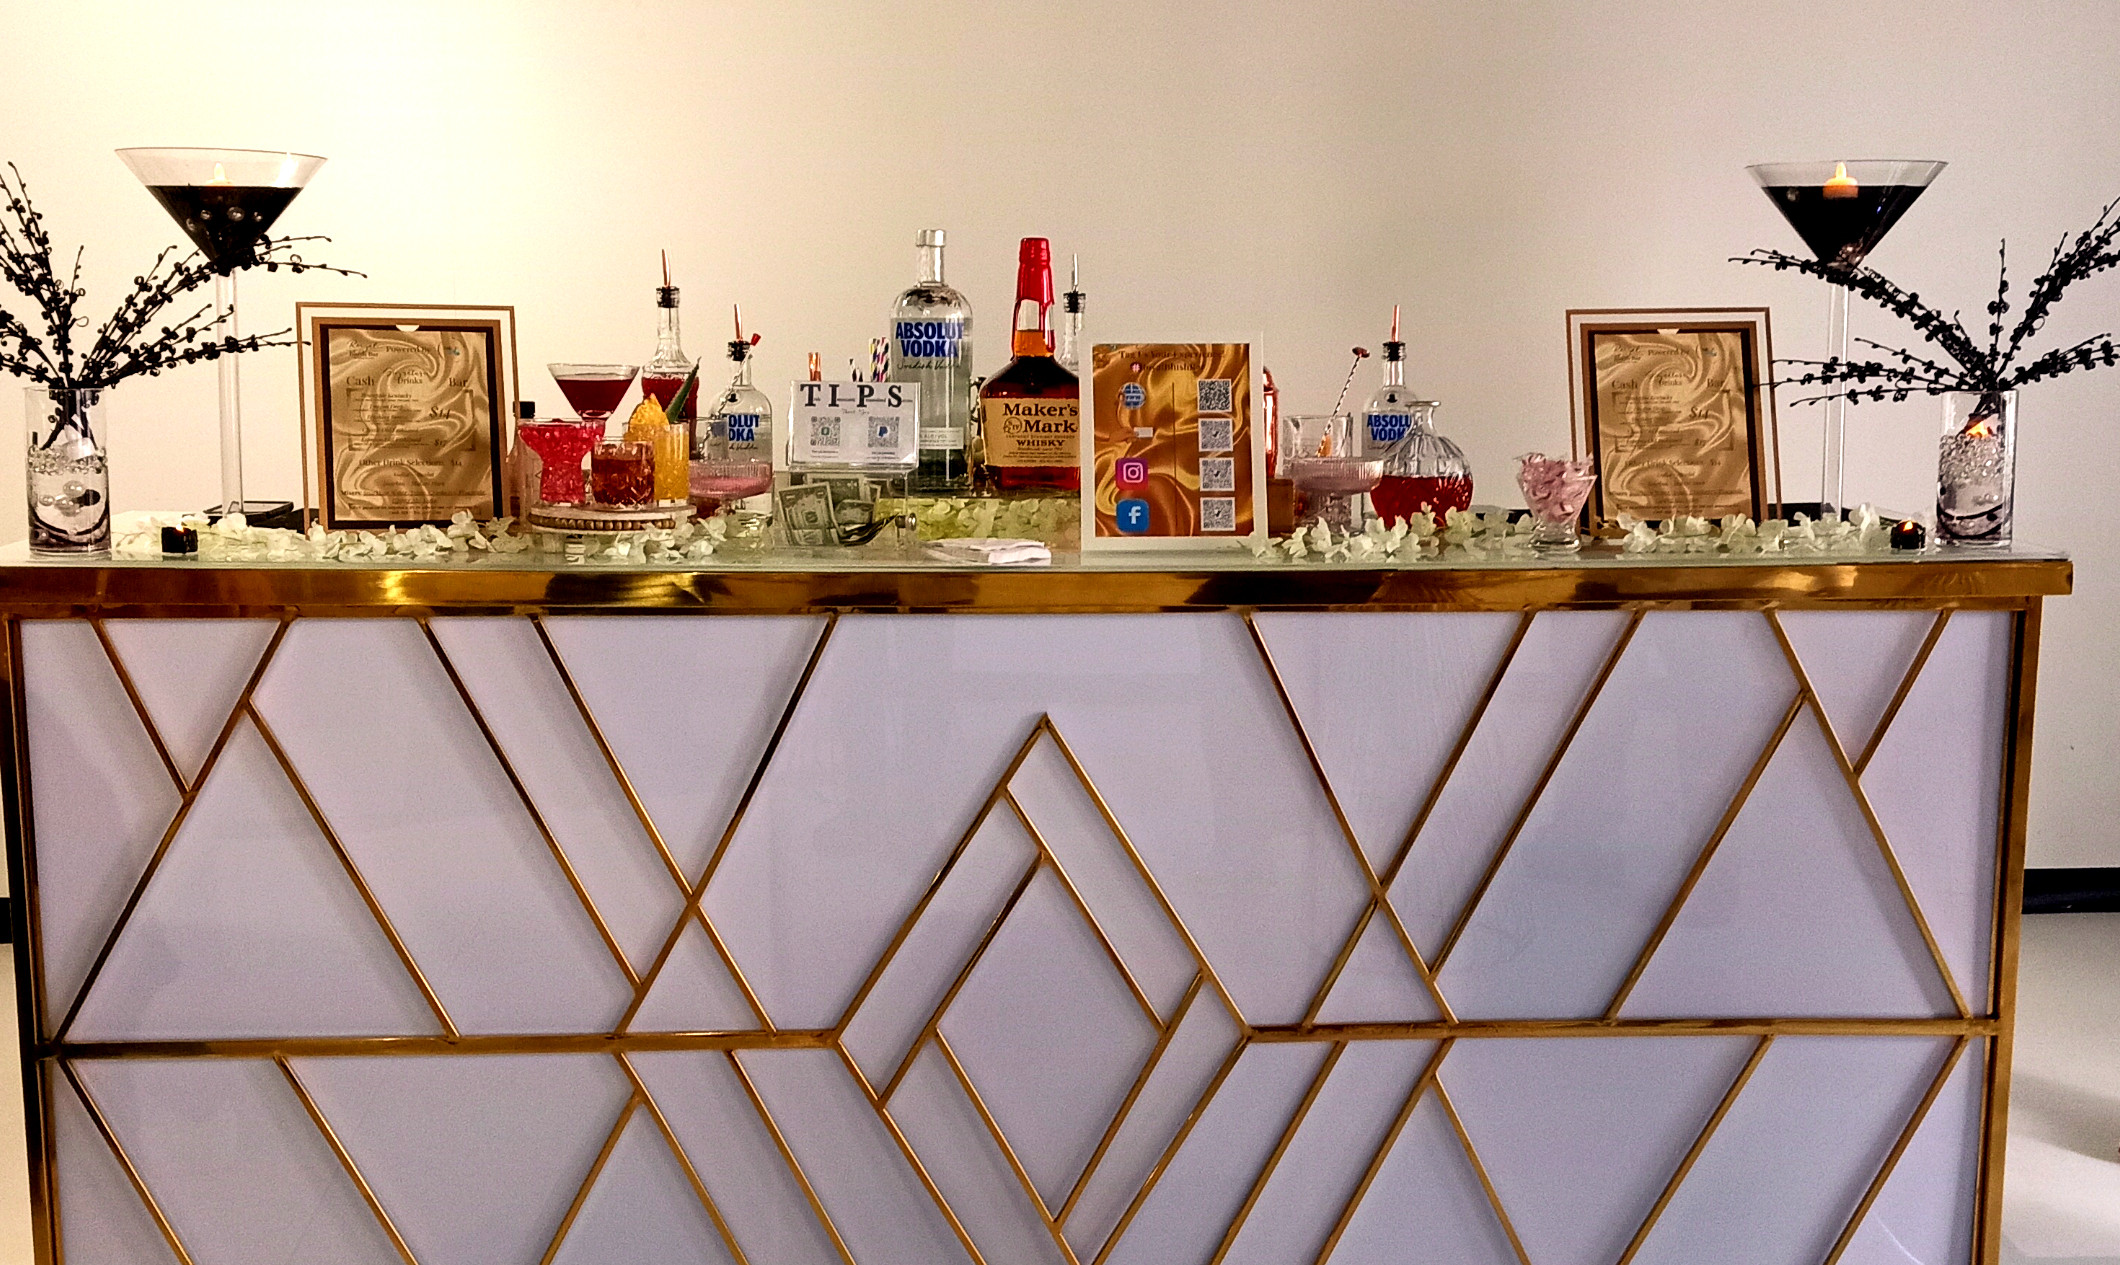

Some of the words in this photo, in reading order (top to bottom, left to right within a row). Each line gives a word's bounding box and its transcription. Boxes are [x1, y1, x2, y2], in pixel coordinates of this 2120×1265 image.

[896, 322, 964, 339] ABSOLUT
[901, 340, 958, 357] VODKA
[346, 376, 375, 387] Cash
[397, 377, 423, 386] Drinks
[449, 378, 468, 388] Bar
[1612, 379, 1638, 390] Cash
[800, 383, 902, 408] TIPS
[1002, 403, 1078, 417] Maker's
[728, 414, 760, 428] OLUT
[1022, 419, 1077, 433] Mark
[1367, 414, 1412, 428] ABSOLU
[728, 428, 755, 441] DKA
[1371, 428, 1407, 441] VODK
[1016, 440, 1065, 448] WHISKY
